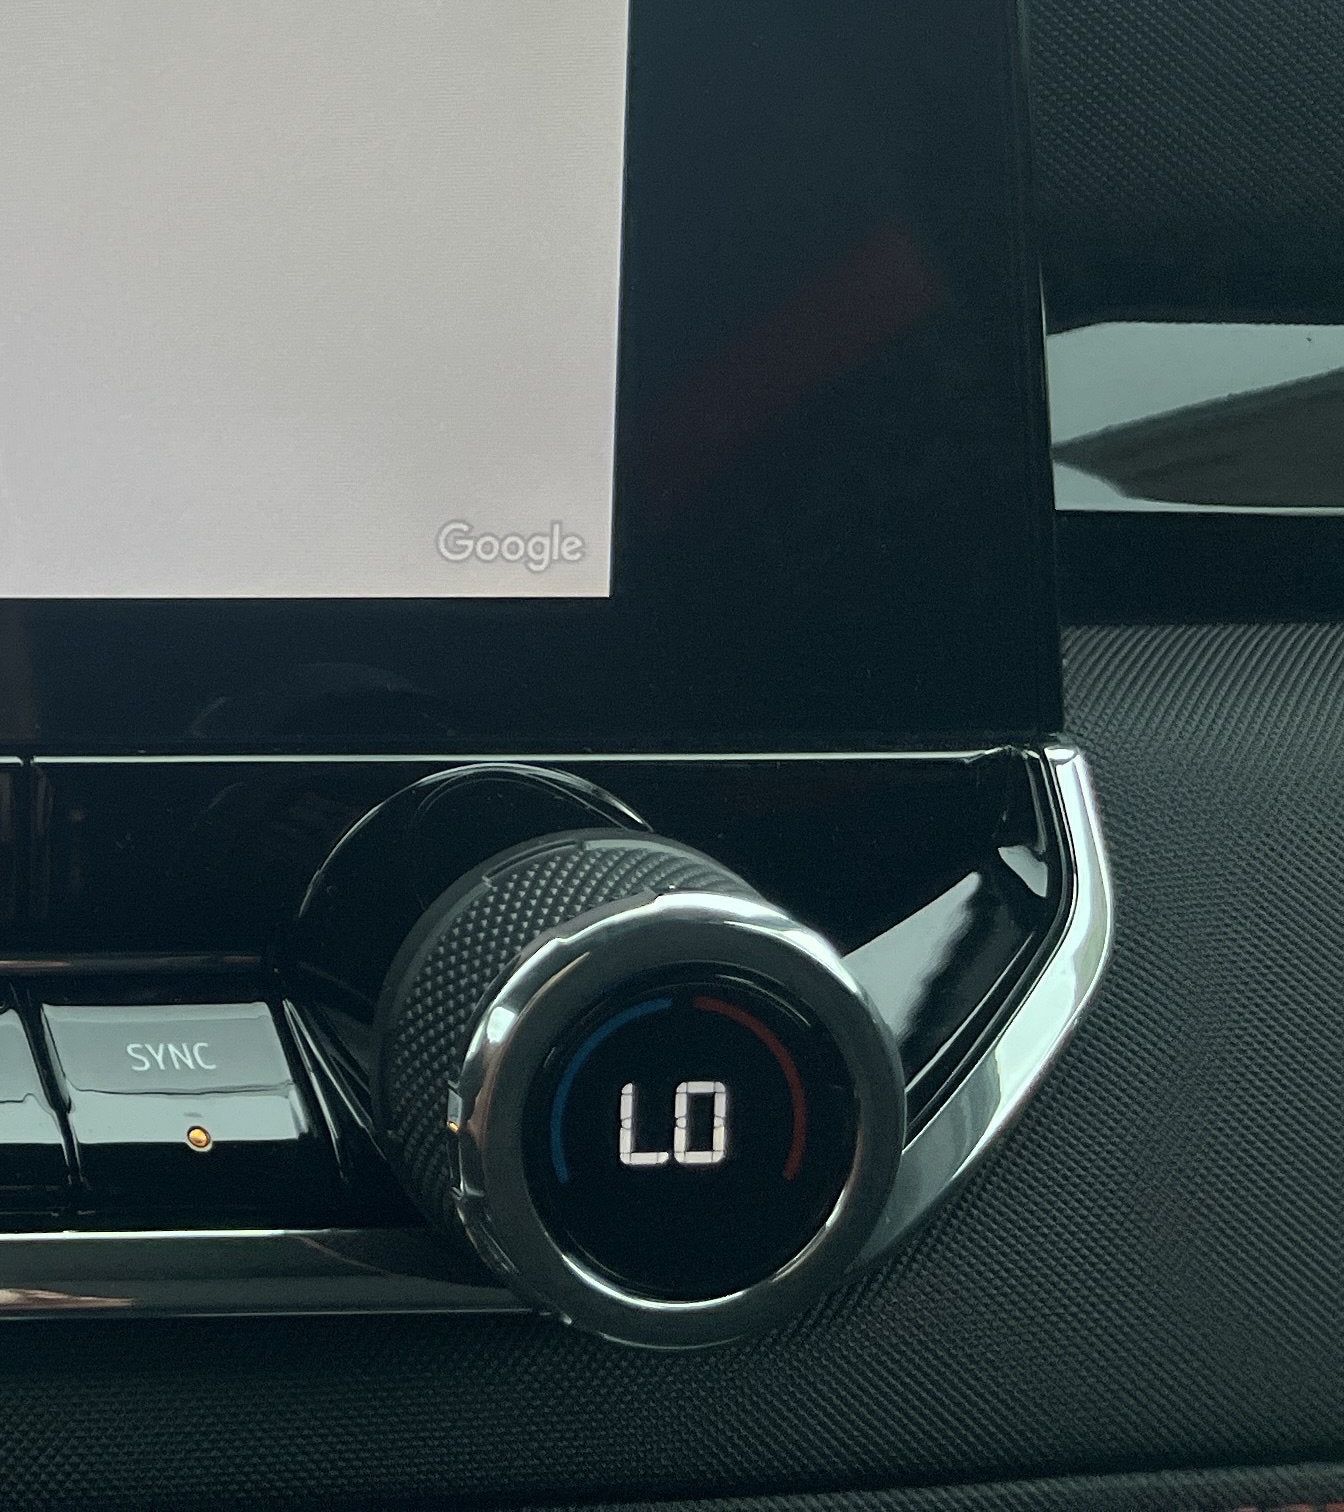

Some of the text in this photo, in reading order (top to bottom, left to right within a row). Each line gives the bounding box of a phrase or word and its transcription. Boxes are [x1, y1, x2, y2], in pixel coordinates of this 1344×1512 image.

[435, 520, 586, 573] Google
[125, 1041, 219, 1073] SYNC
[618, 1079, 728, 1166] LO
